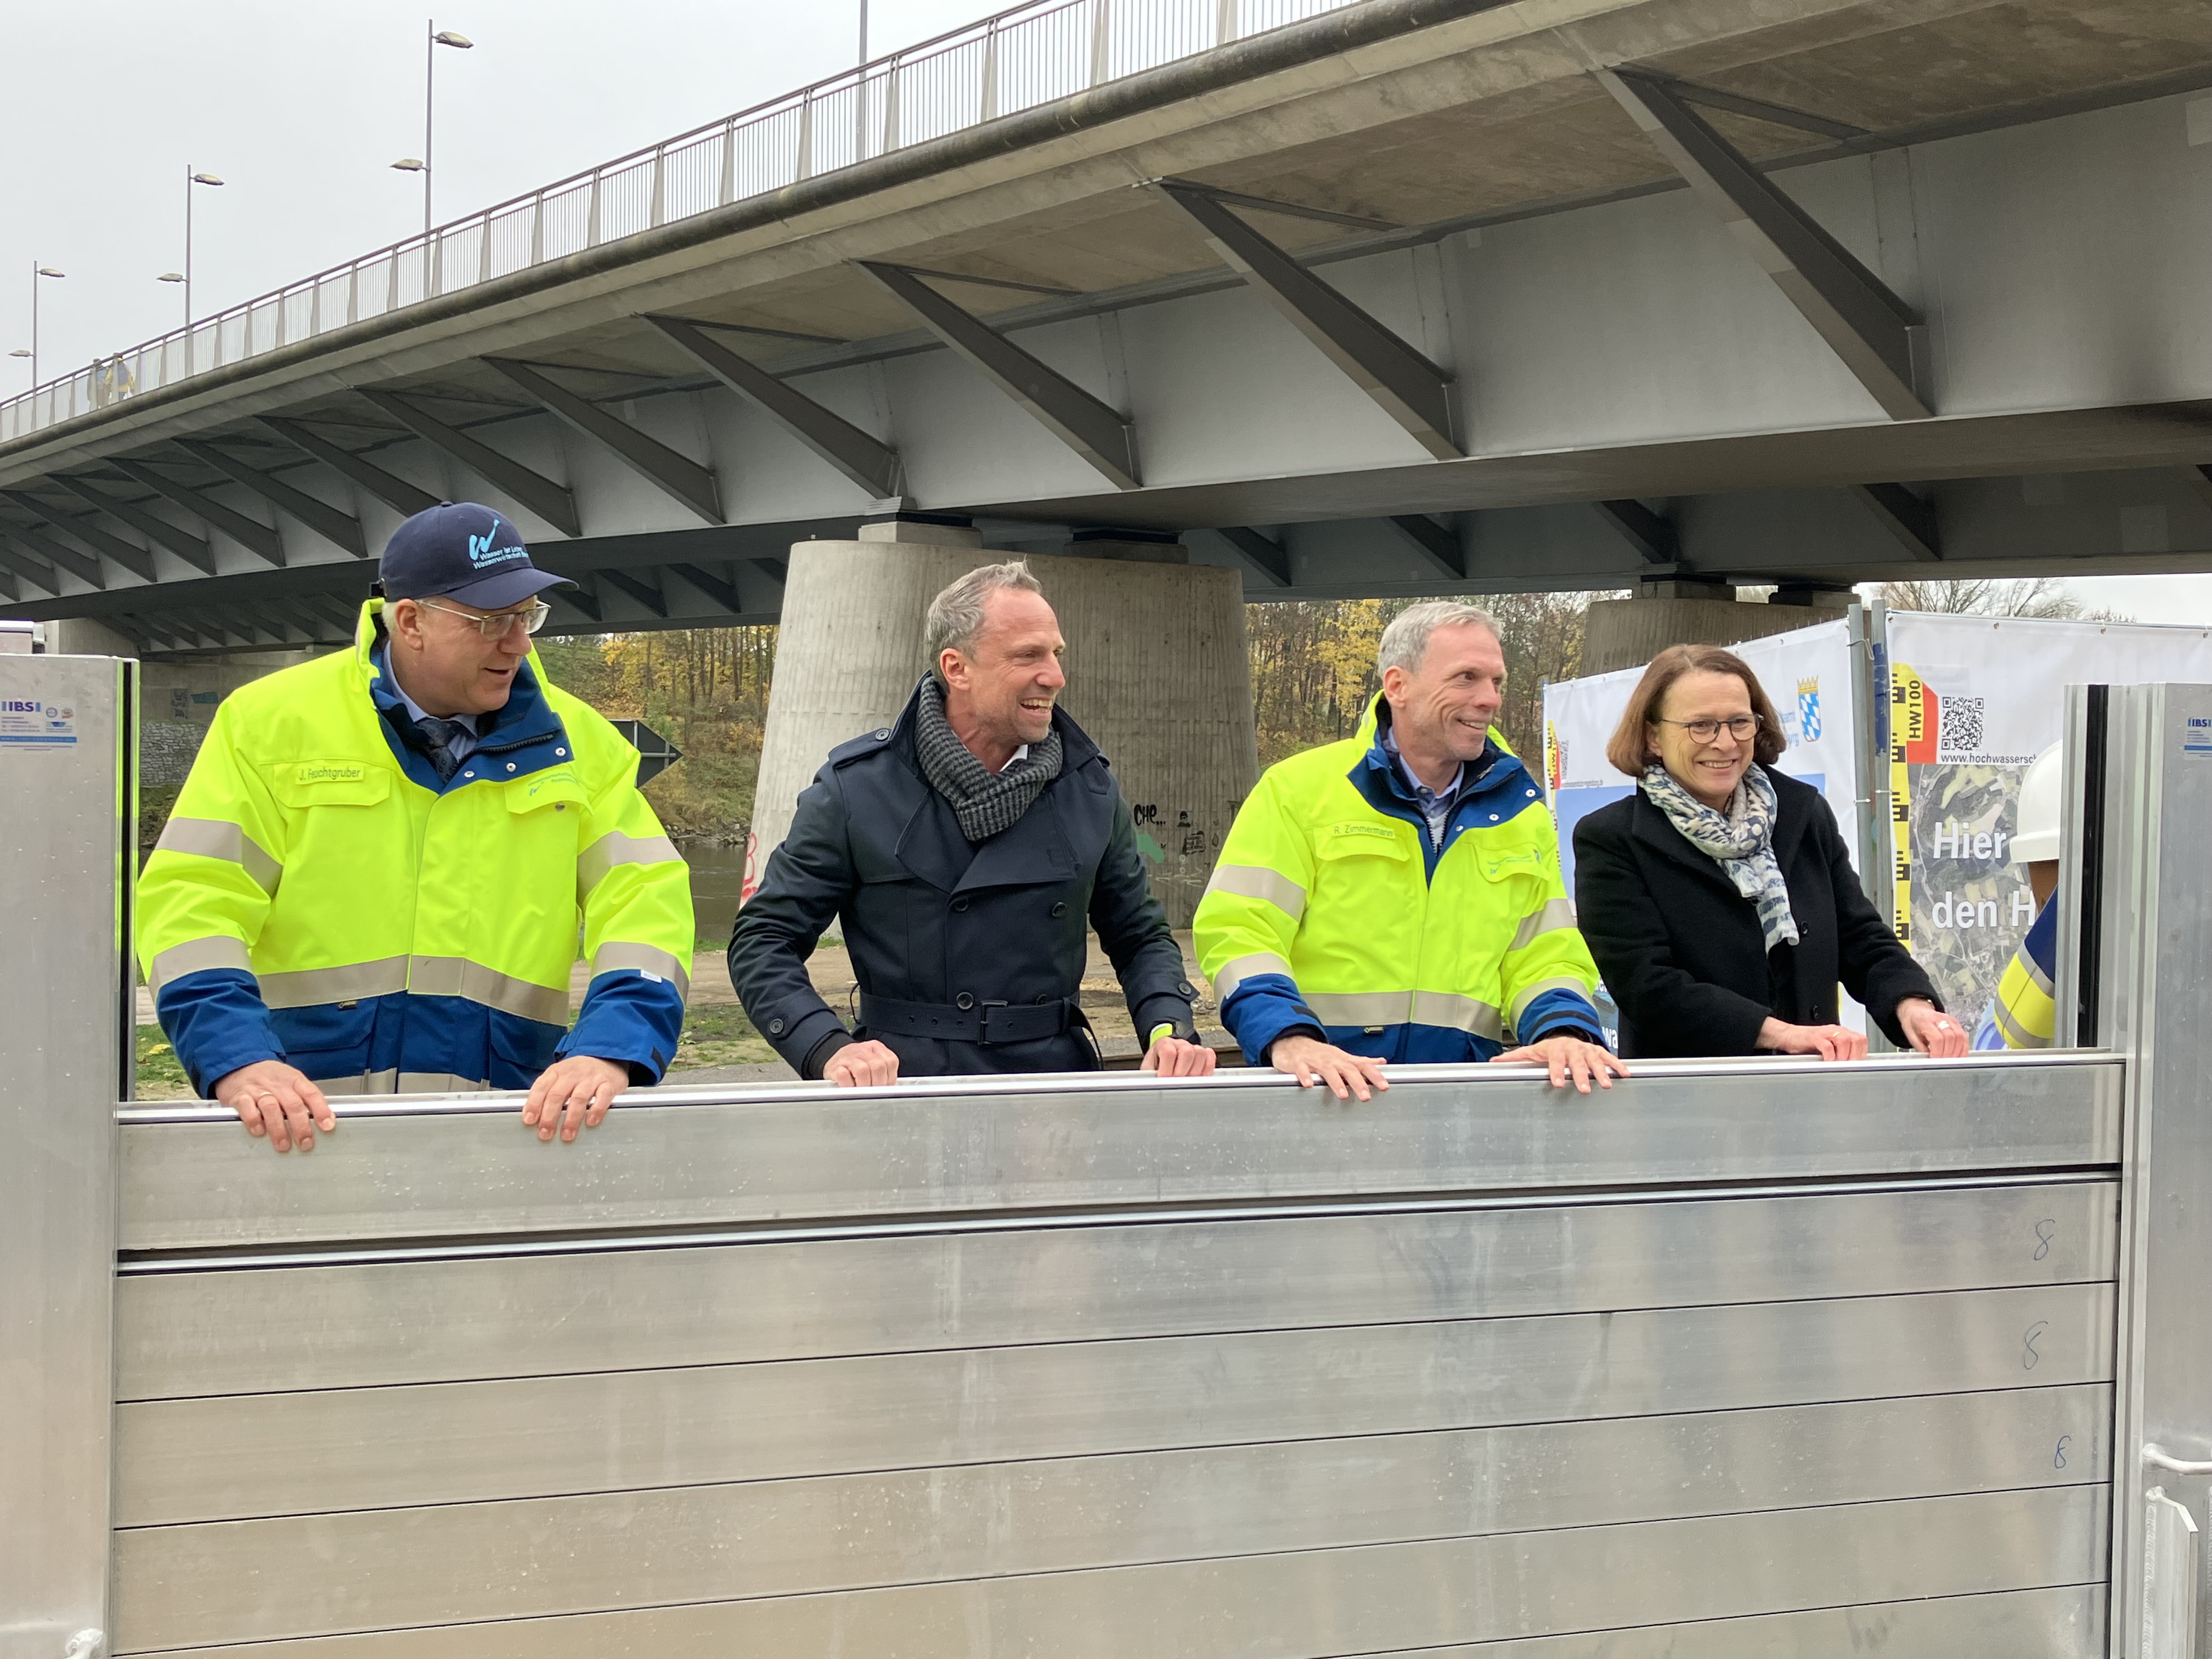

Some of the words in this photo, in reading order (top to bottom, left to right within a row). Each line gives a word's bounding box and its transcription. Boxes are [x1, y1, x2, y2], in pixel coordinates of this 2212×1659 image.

[1909, 680, 1921, 738] HW100
[1941, 753, 2037, 764] www.hochwassersch
[1345, 825, 1393, 837] Zimmermann
[1933, 822, 2007, 860] Hier
[1932, 891, 1997, 928] den
[2012, 890, 2036, 927] H
[2034, 1218, 2055, 1261] 8
[2023, 1321, 2048, 1370] 8
